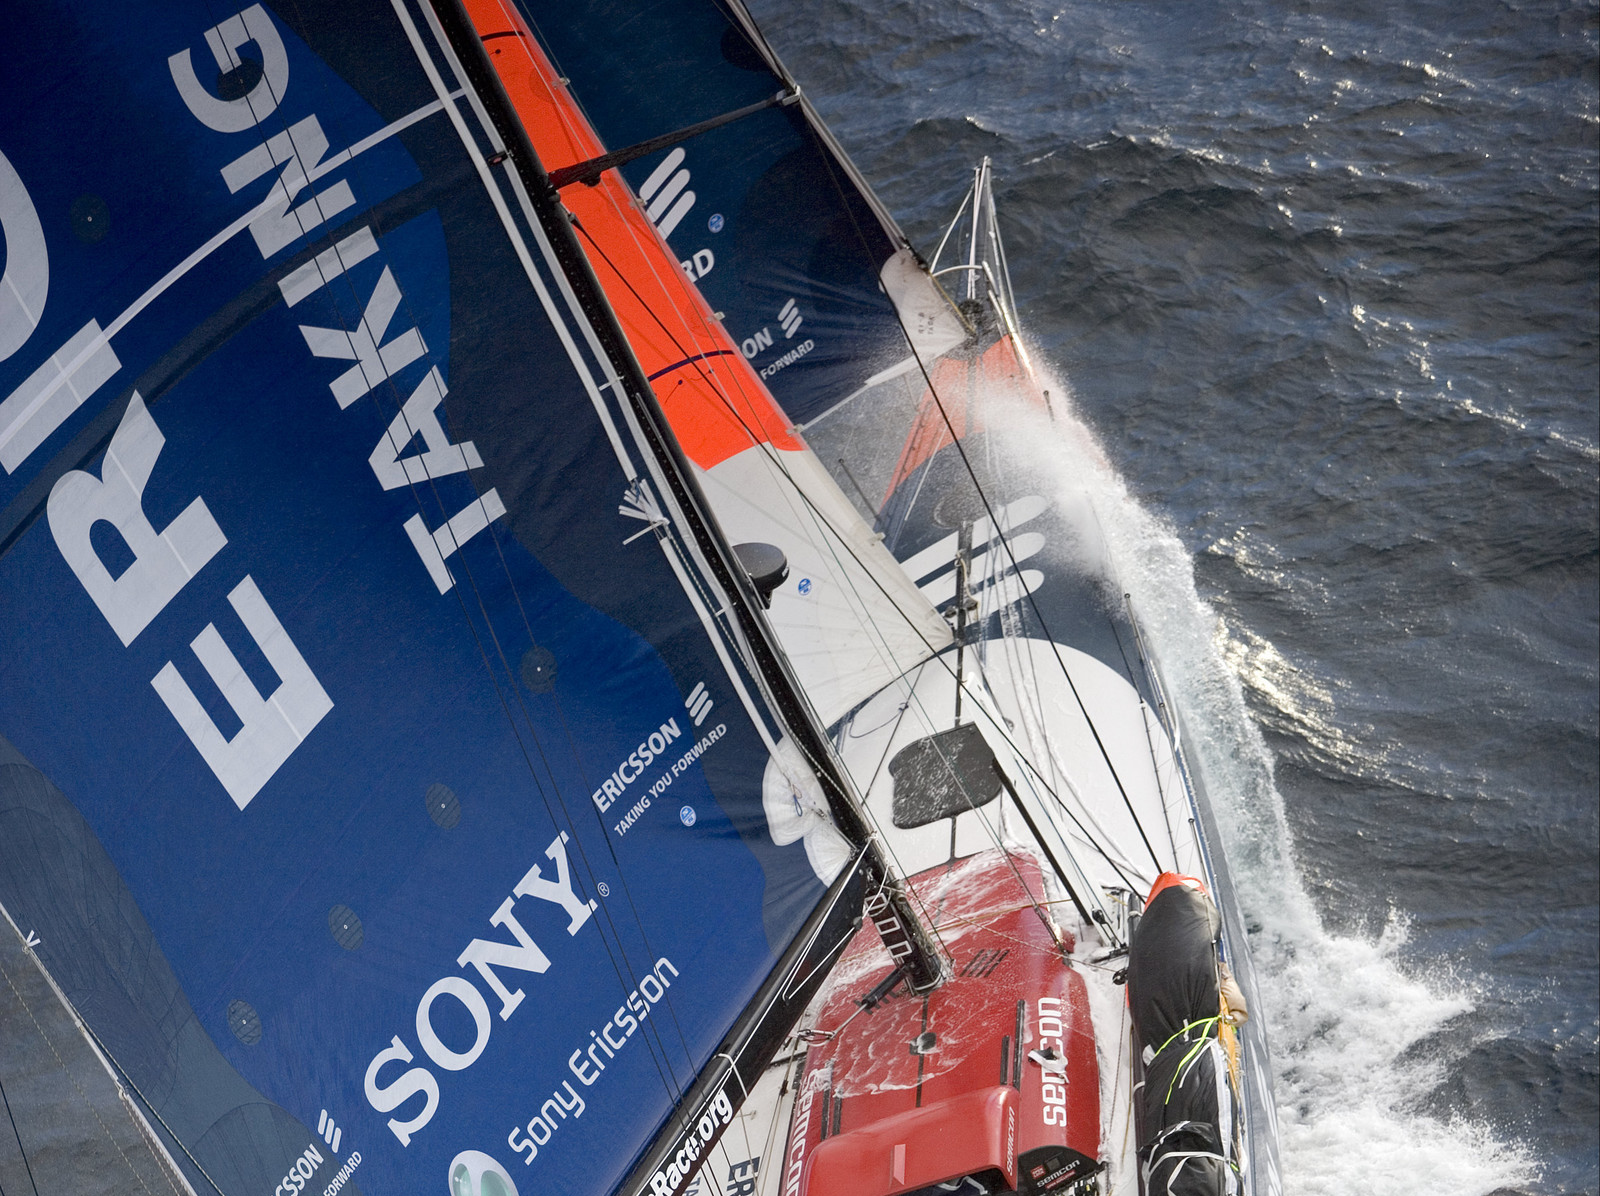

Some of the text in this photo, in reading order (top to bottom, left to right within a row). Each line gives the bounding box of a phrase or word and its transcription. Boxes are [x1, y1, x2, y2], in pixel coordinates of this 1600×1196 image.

[168, 3, 507, 596] TAKING
[759, 339, 815, 380] FORWARD
[592, 717, 682, 814] ERICSSON
[614, 795, 651, 837] TAKING
[648, 772, 673, 799] YOU
[671, 723, 727, 778] FORWARD
[364, 831, 598, 1147] SONY
[508, 957, 680, 1166] Sony Ericsson
[1036, 1159, 1080, 1188] semcon
